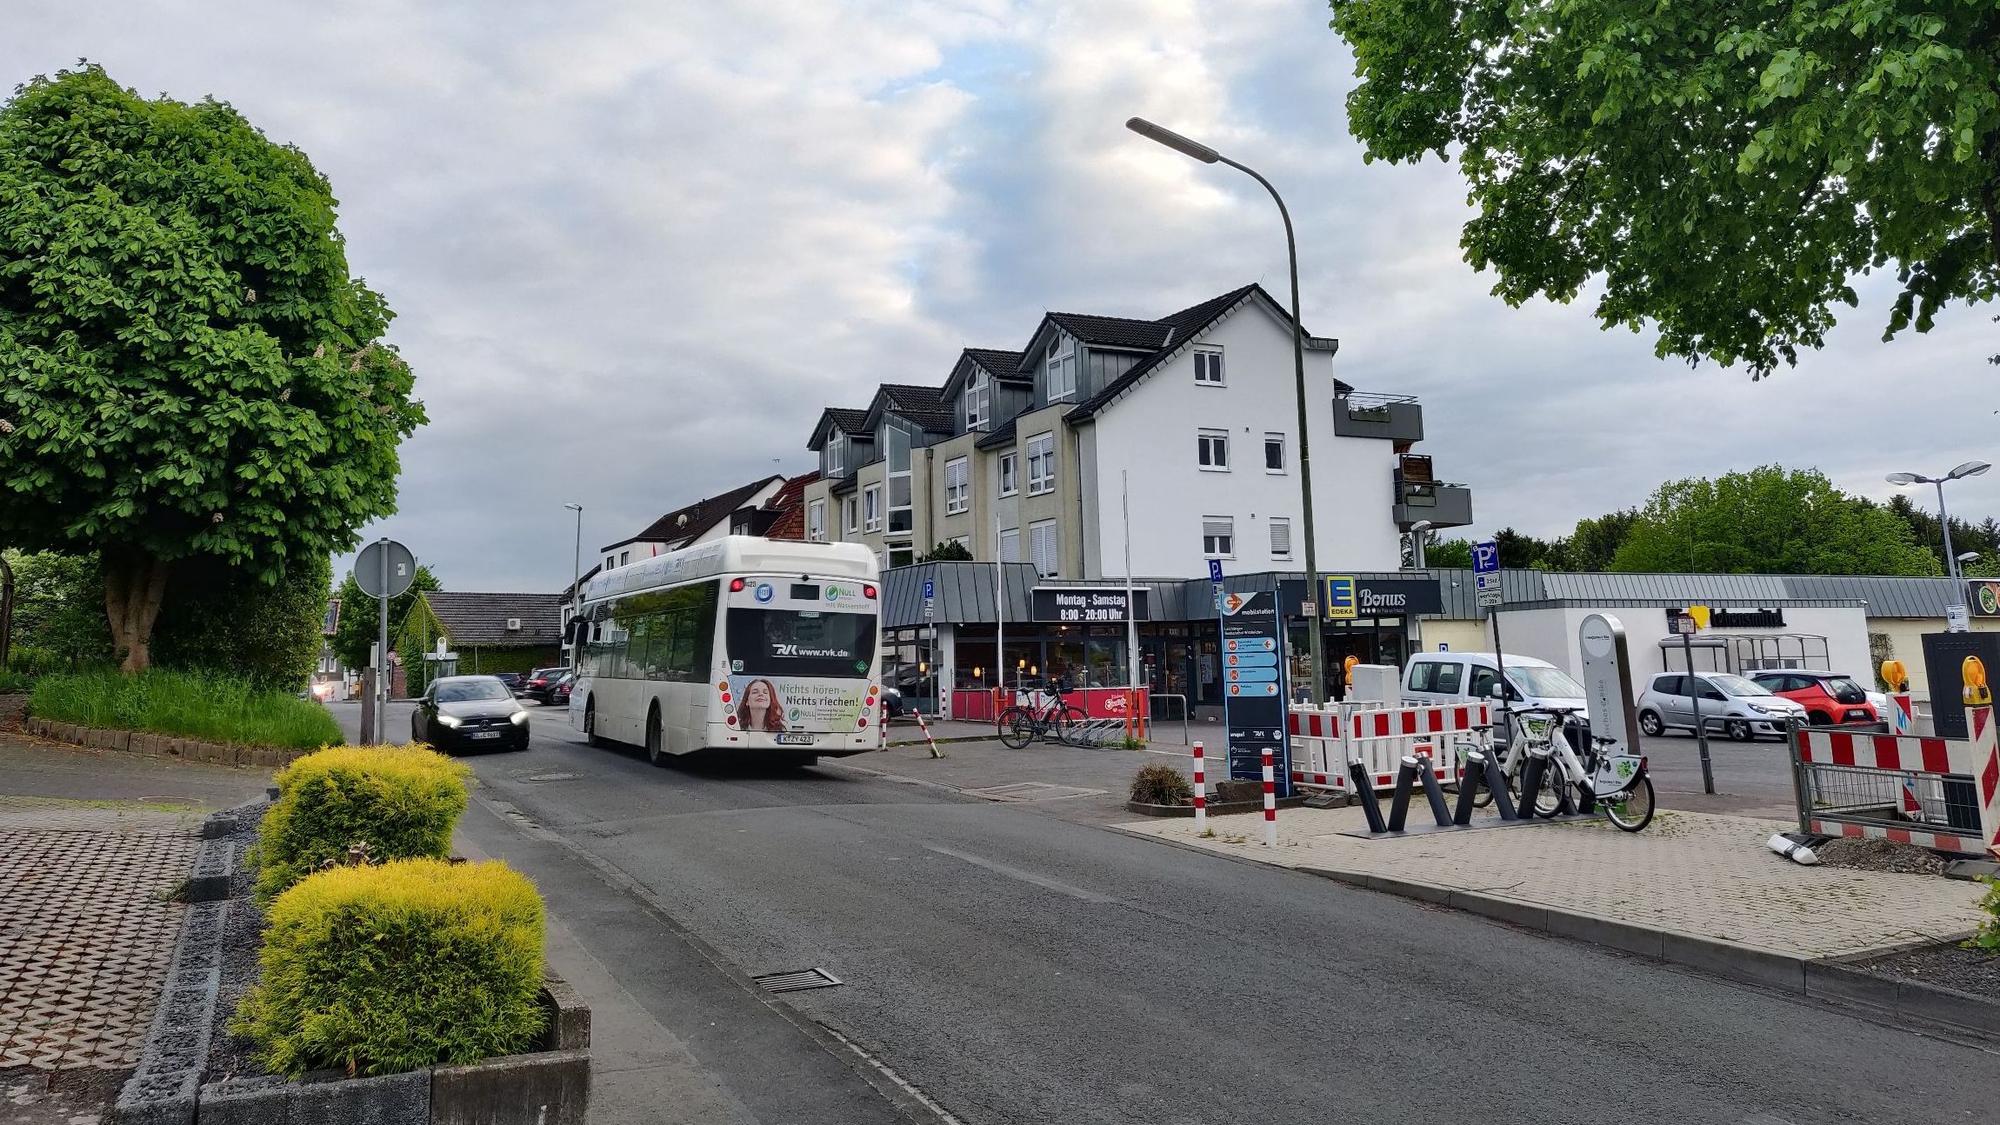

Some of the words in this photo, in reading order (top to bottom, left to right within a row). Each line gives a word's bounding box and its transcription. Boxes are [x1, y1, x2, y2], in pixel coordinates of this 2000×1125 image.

[1056, 593, 1086, 607] Montag
[1092, 593, 1126, 607] Samstag
[1060, 609, 1078, 620] 8:00
[1085, 609, 1108, 620] 20:00
[1108, 608, 1123, 620] Uhr
[1241, 608, 1275, 616] mobilstation
[798, 648, 849, 657] www.rvk.de
[779, 683, 811, 695] Nichts
[785, 695, 817, 706] Nichts
[819, 697, 859, 707] riechen!
